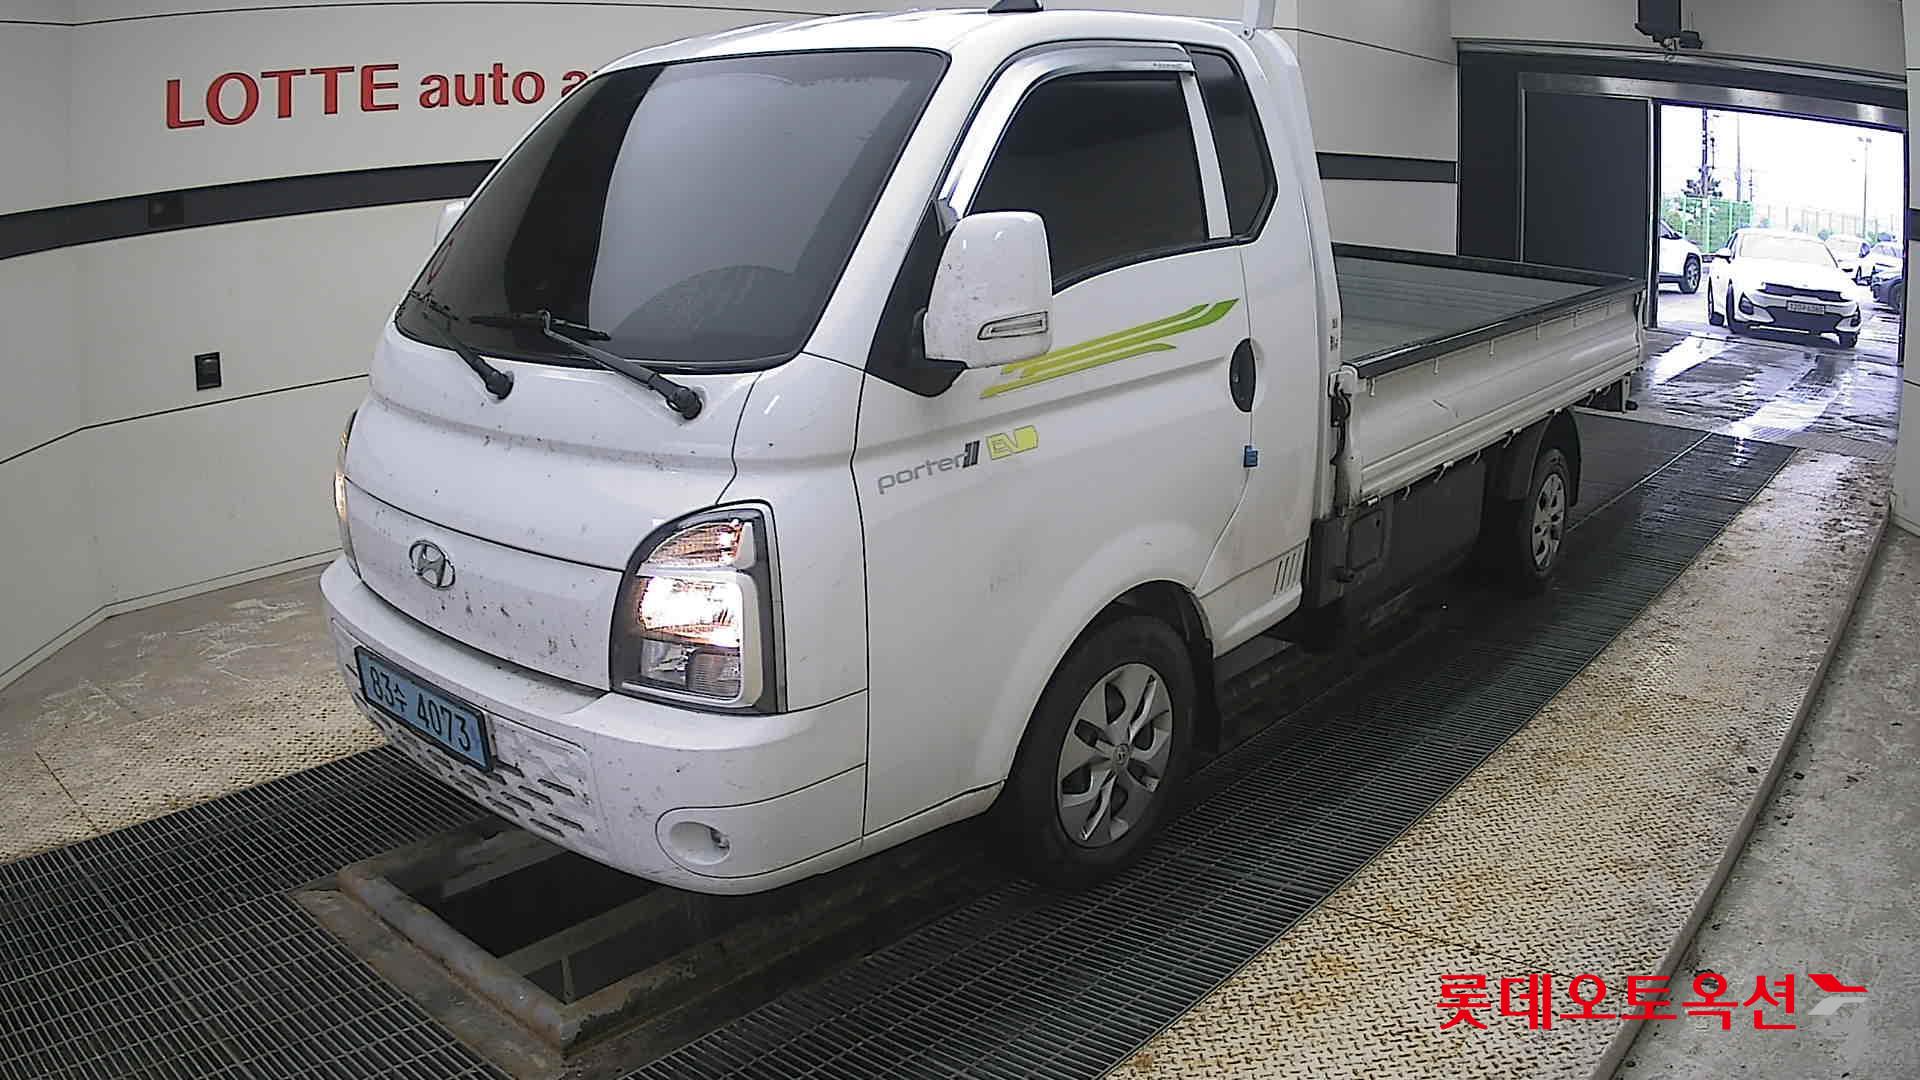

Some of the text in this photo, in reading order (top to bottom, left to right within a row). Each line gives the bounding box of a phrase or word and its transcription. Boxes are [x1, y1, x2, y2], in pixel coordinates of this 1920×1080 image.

[166, 64, 399, 129] LOTTE
[418, 62, 545, 108] auto
[986, 426, 1034, 460] EV
[417, 691, 471, 751] 4073
